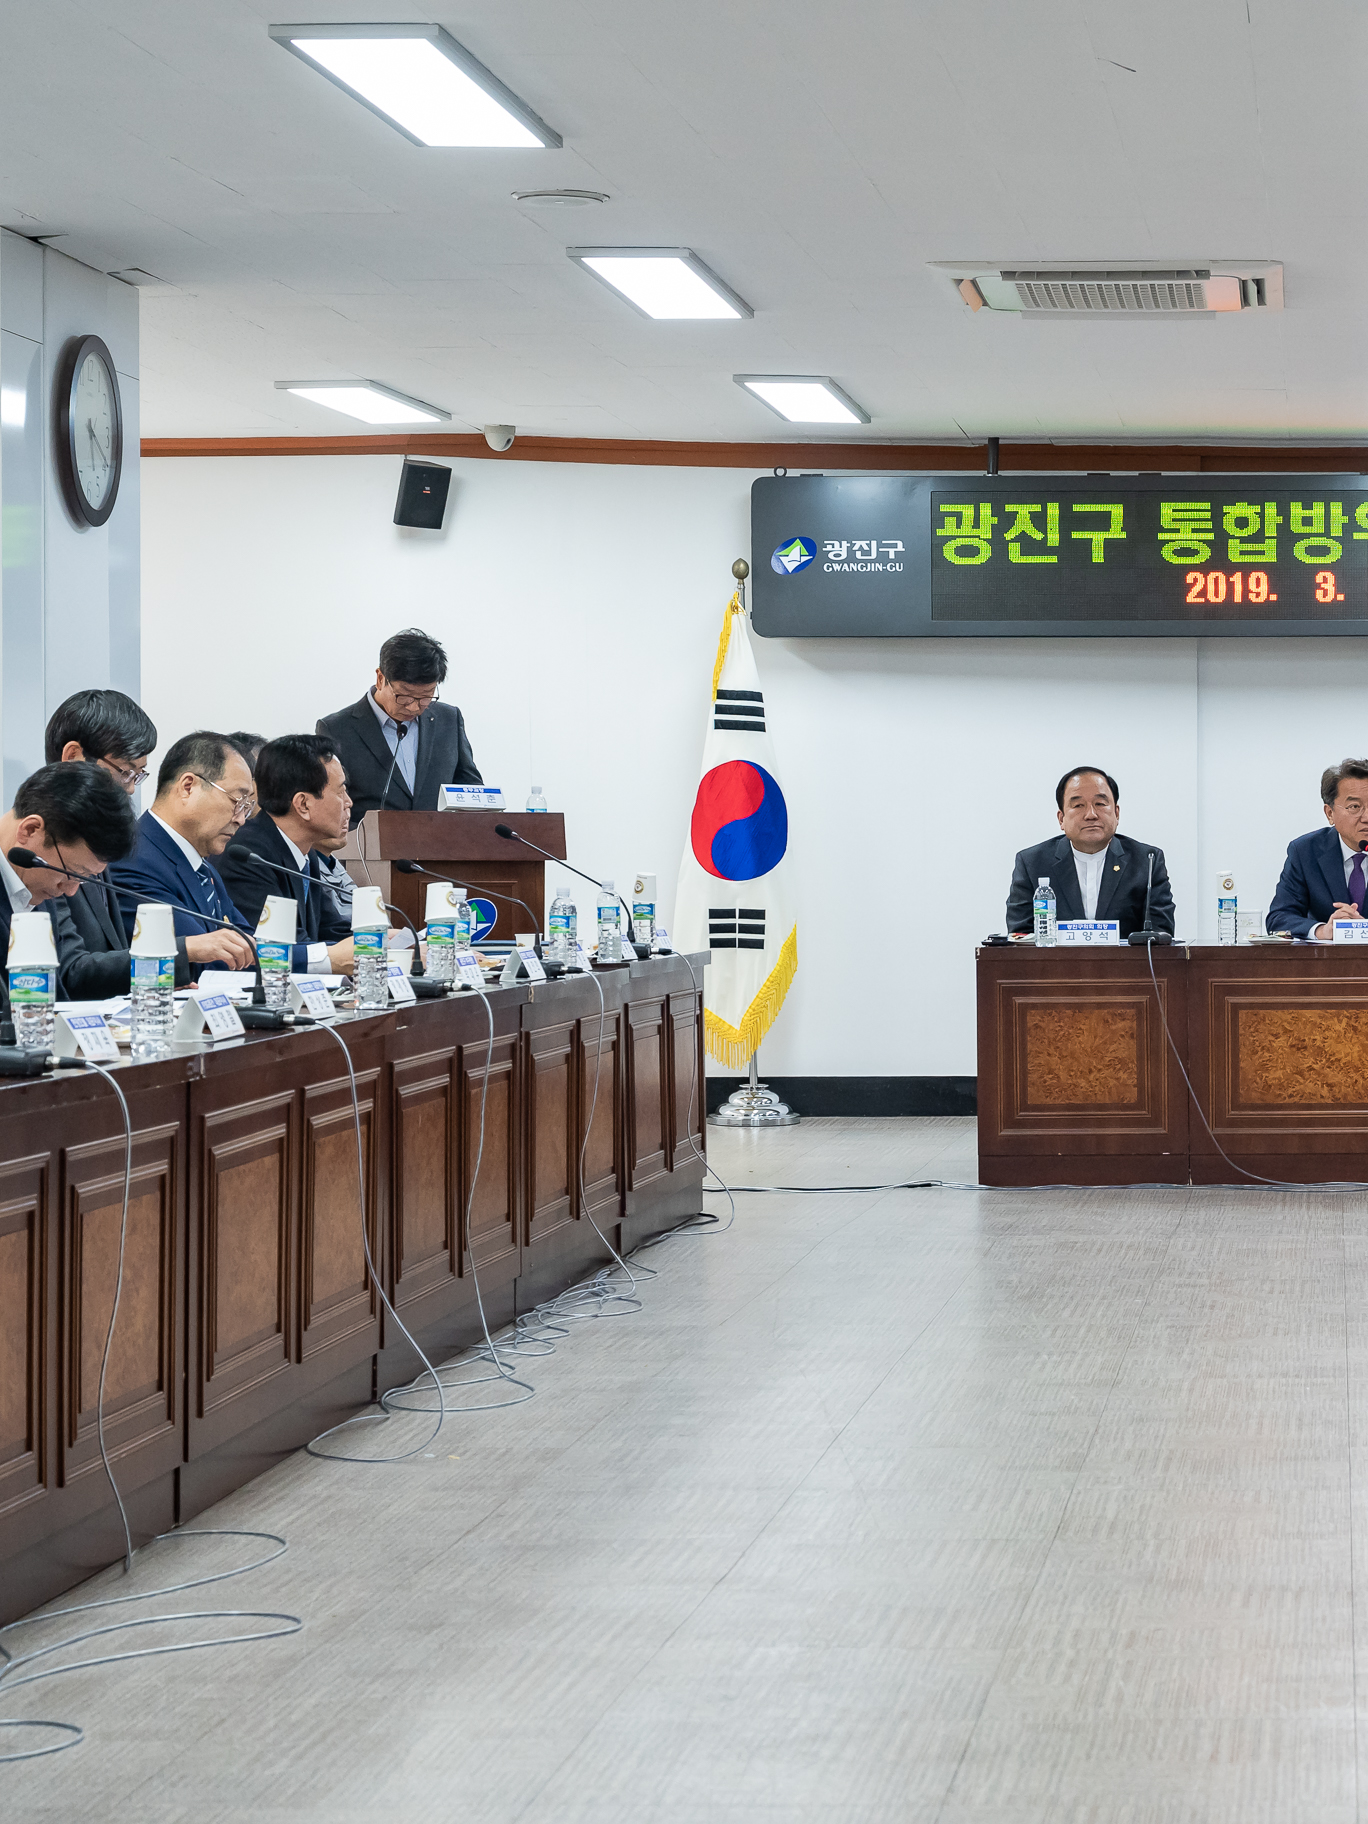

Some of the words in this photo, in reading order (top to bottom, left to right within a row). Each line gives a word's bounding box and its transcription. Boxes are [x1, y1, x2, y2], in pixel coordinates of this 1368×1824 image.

[935, 502, 1127, 565] 광진구
[822, 540, 906, 560] 광진구
[823, 562, 904, 573] GWANGJIN-GU
[1185, 571, 1278, 603] 2019.
[1314, 571, 1345, 603] 3.
[1065, 931, 1109, 941] 고양석
